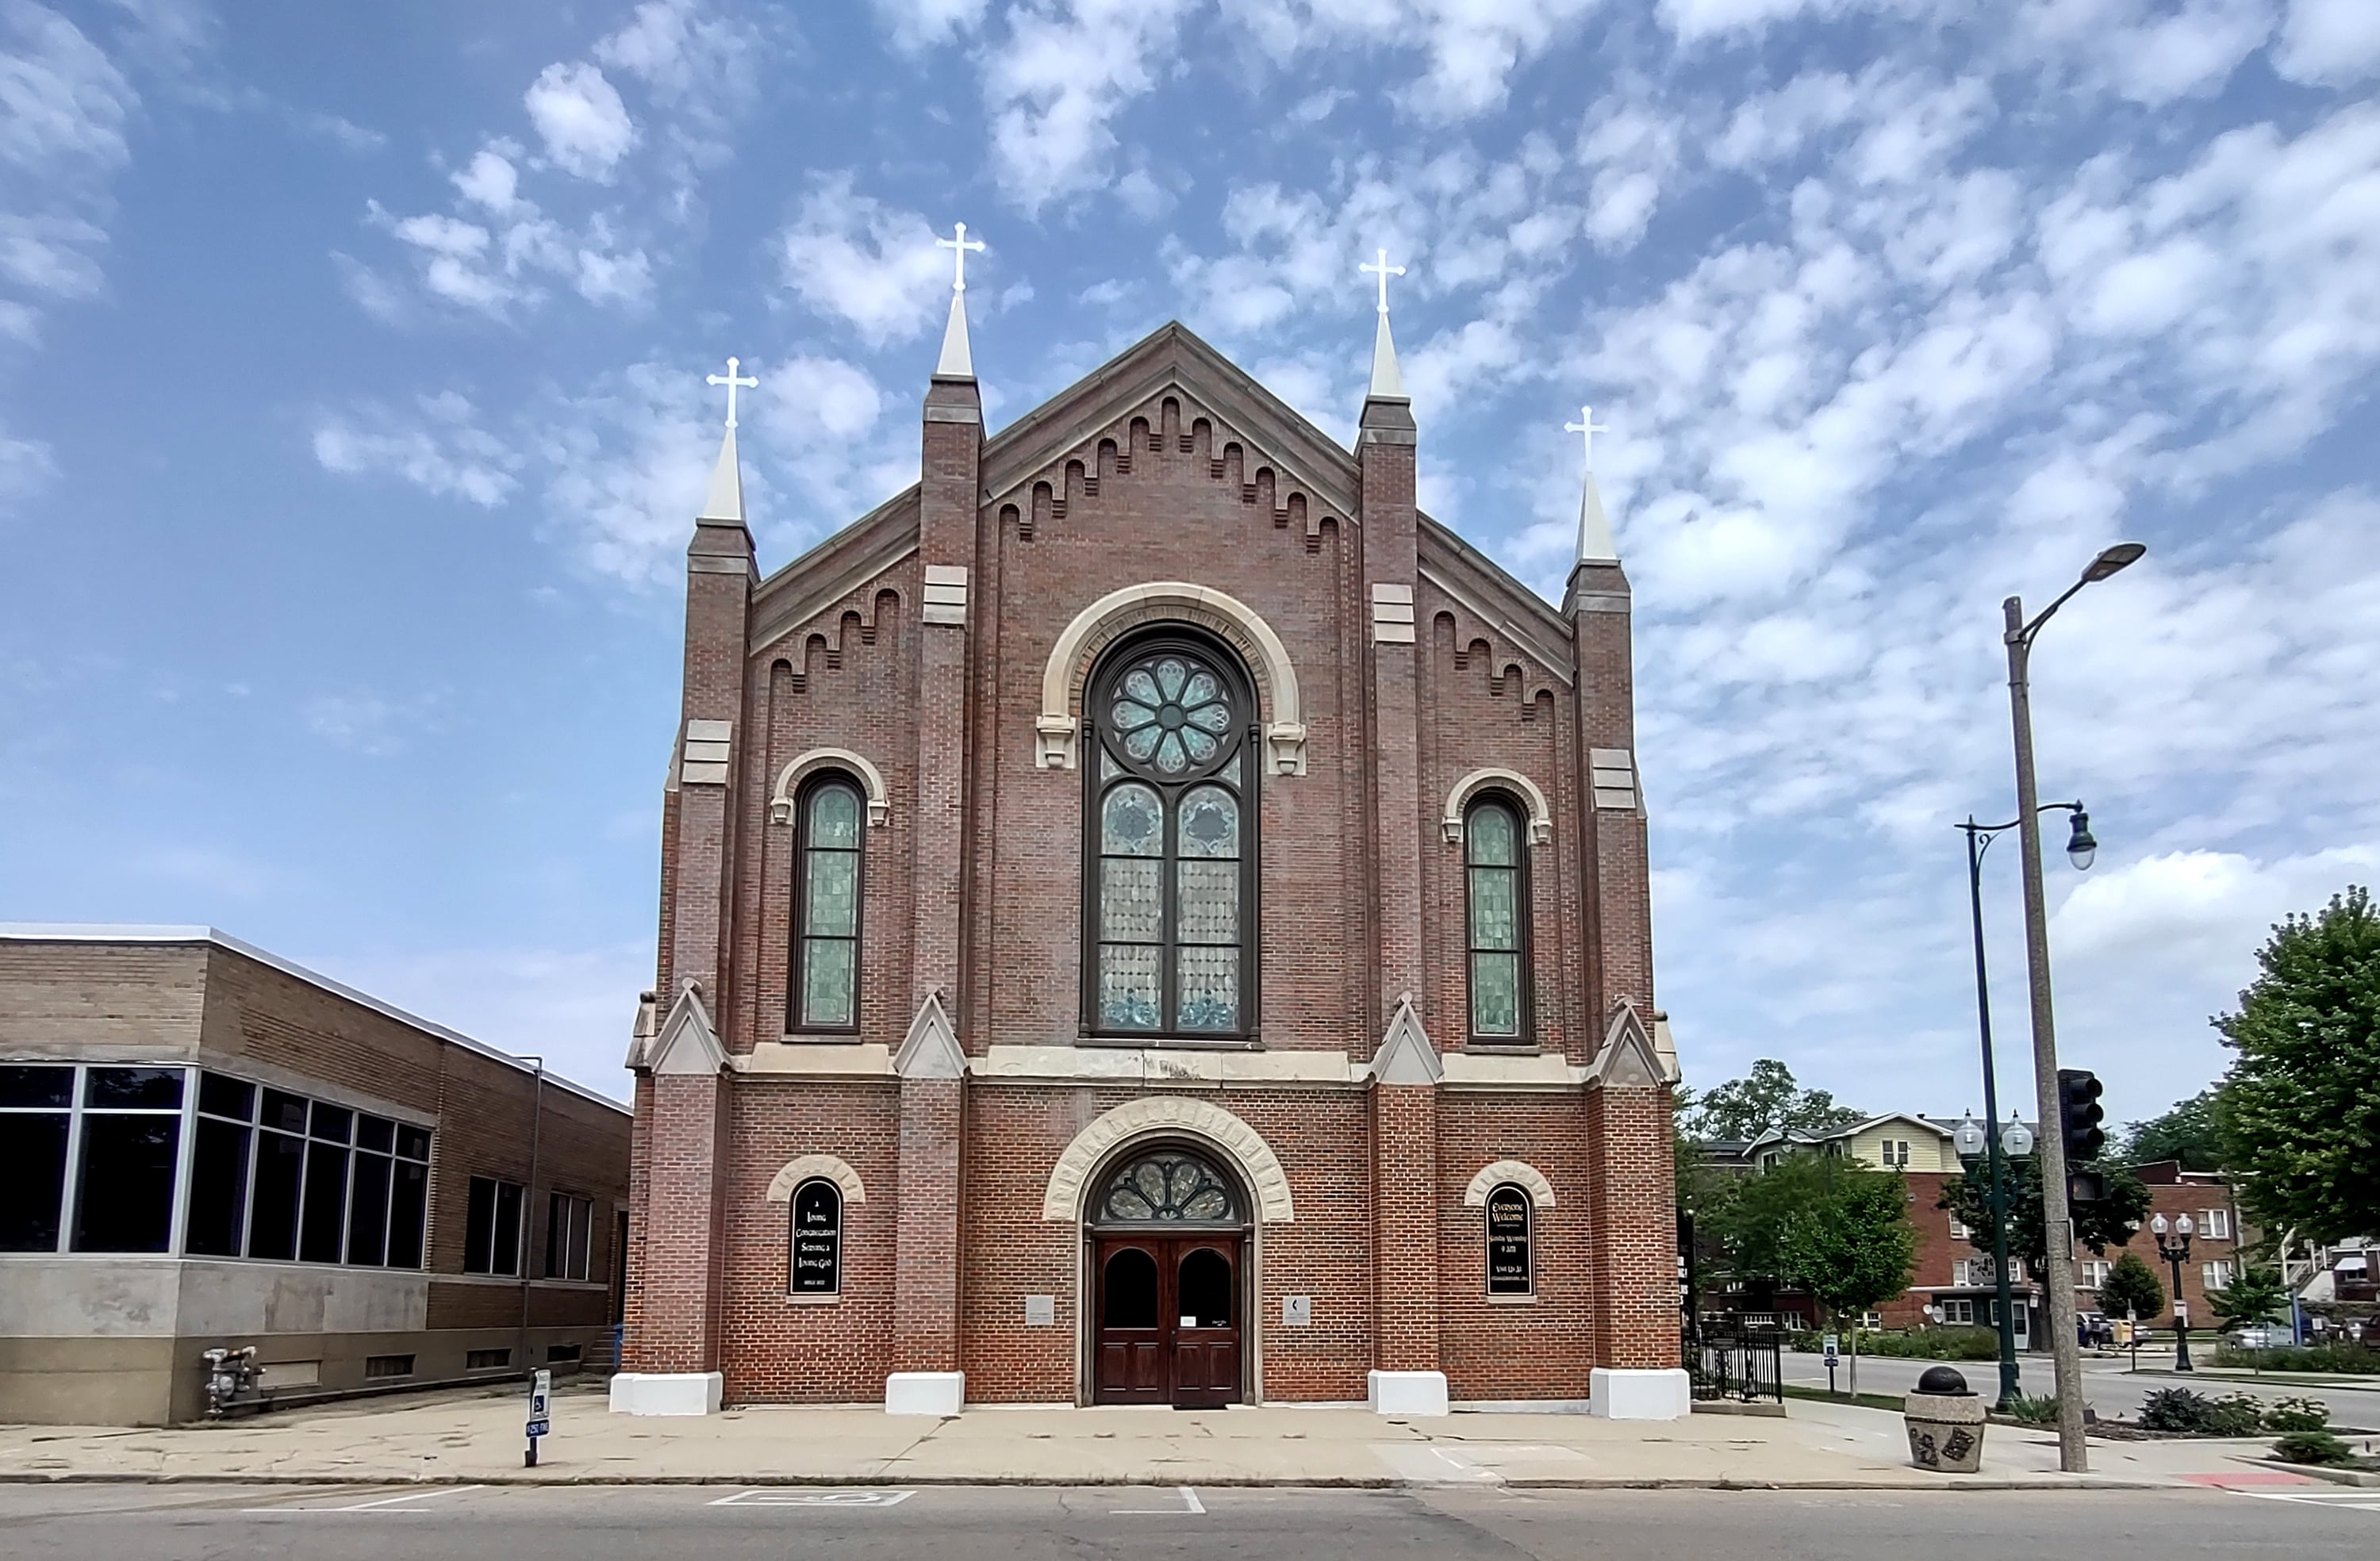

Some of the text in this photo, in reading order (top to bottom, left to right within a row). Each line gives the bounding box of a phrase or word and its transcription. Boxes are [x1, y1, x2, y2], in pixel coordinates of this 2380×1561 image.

[1492, 1202, 1523, 1212] Everyone
[1491, 1213, 1523, 1222] Welcome
[818, 1259, 832, 1270] God
